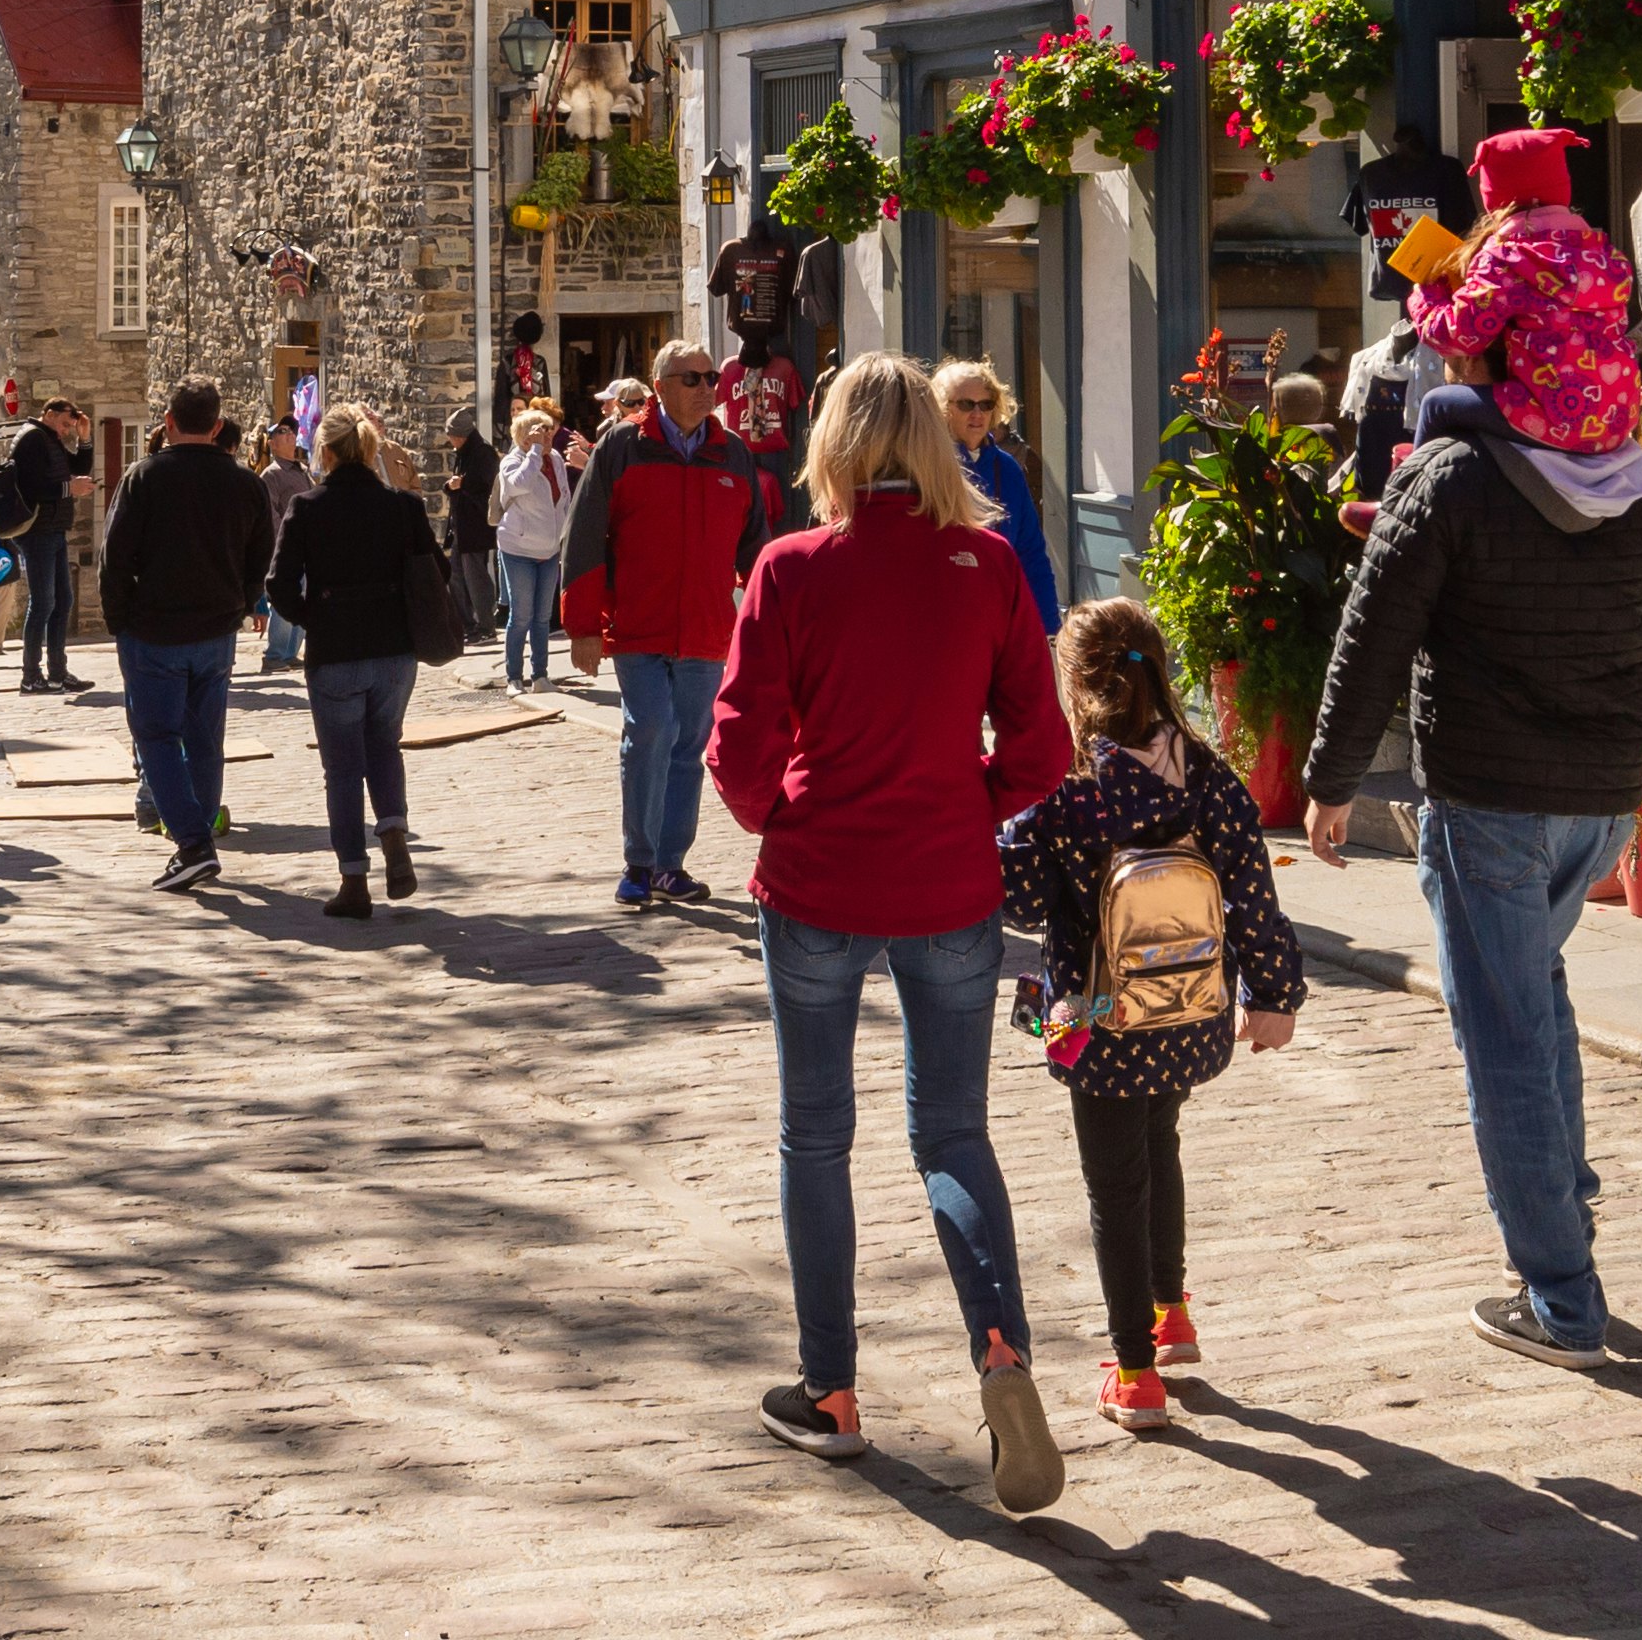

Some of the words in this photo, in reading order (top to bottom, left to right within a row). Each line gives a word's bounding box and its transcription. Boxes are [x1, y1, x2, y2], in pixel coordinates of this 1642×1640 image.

[1368, 197, 1436, 209] QUEBEC
[1374, 237, 1403, 249] CAN
[732, 377, 785, 401] CAADA
